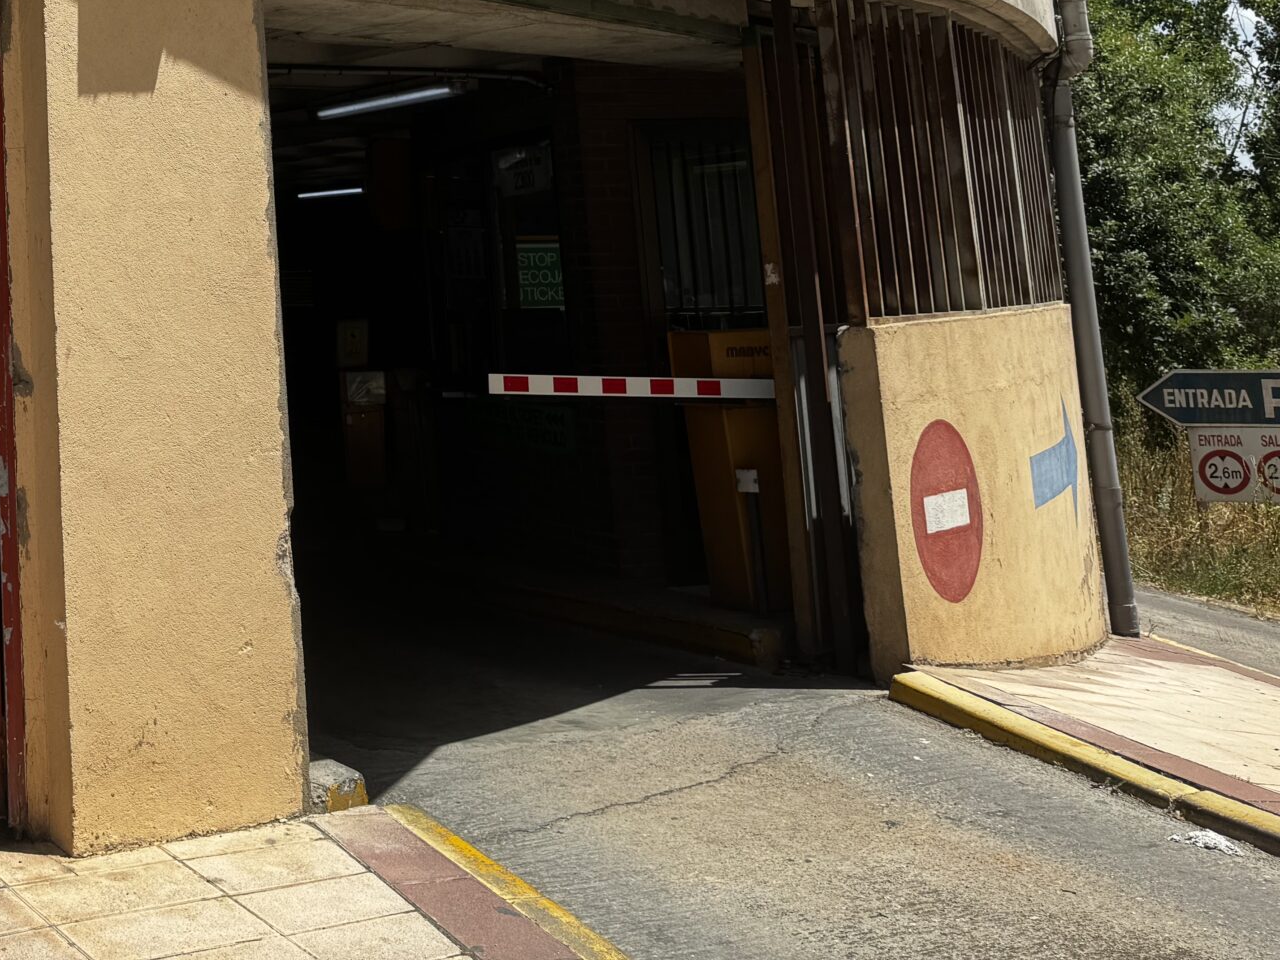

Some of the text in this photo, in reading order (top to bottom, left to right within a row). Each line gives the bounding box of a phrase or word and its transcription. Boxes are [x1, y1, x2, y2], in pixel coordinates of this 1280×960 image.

[518, 252, 557, 267] STOP
[1162, 388, 1254, 409] ENTRADA
[1198, 434, 1243, 447] ENTRADA
[1208, 462, 1242, 481] 2,6m
